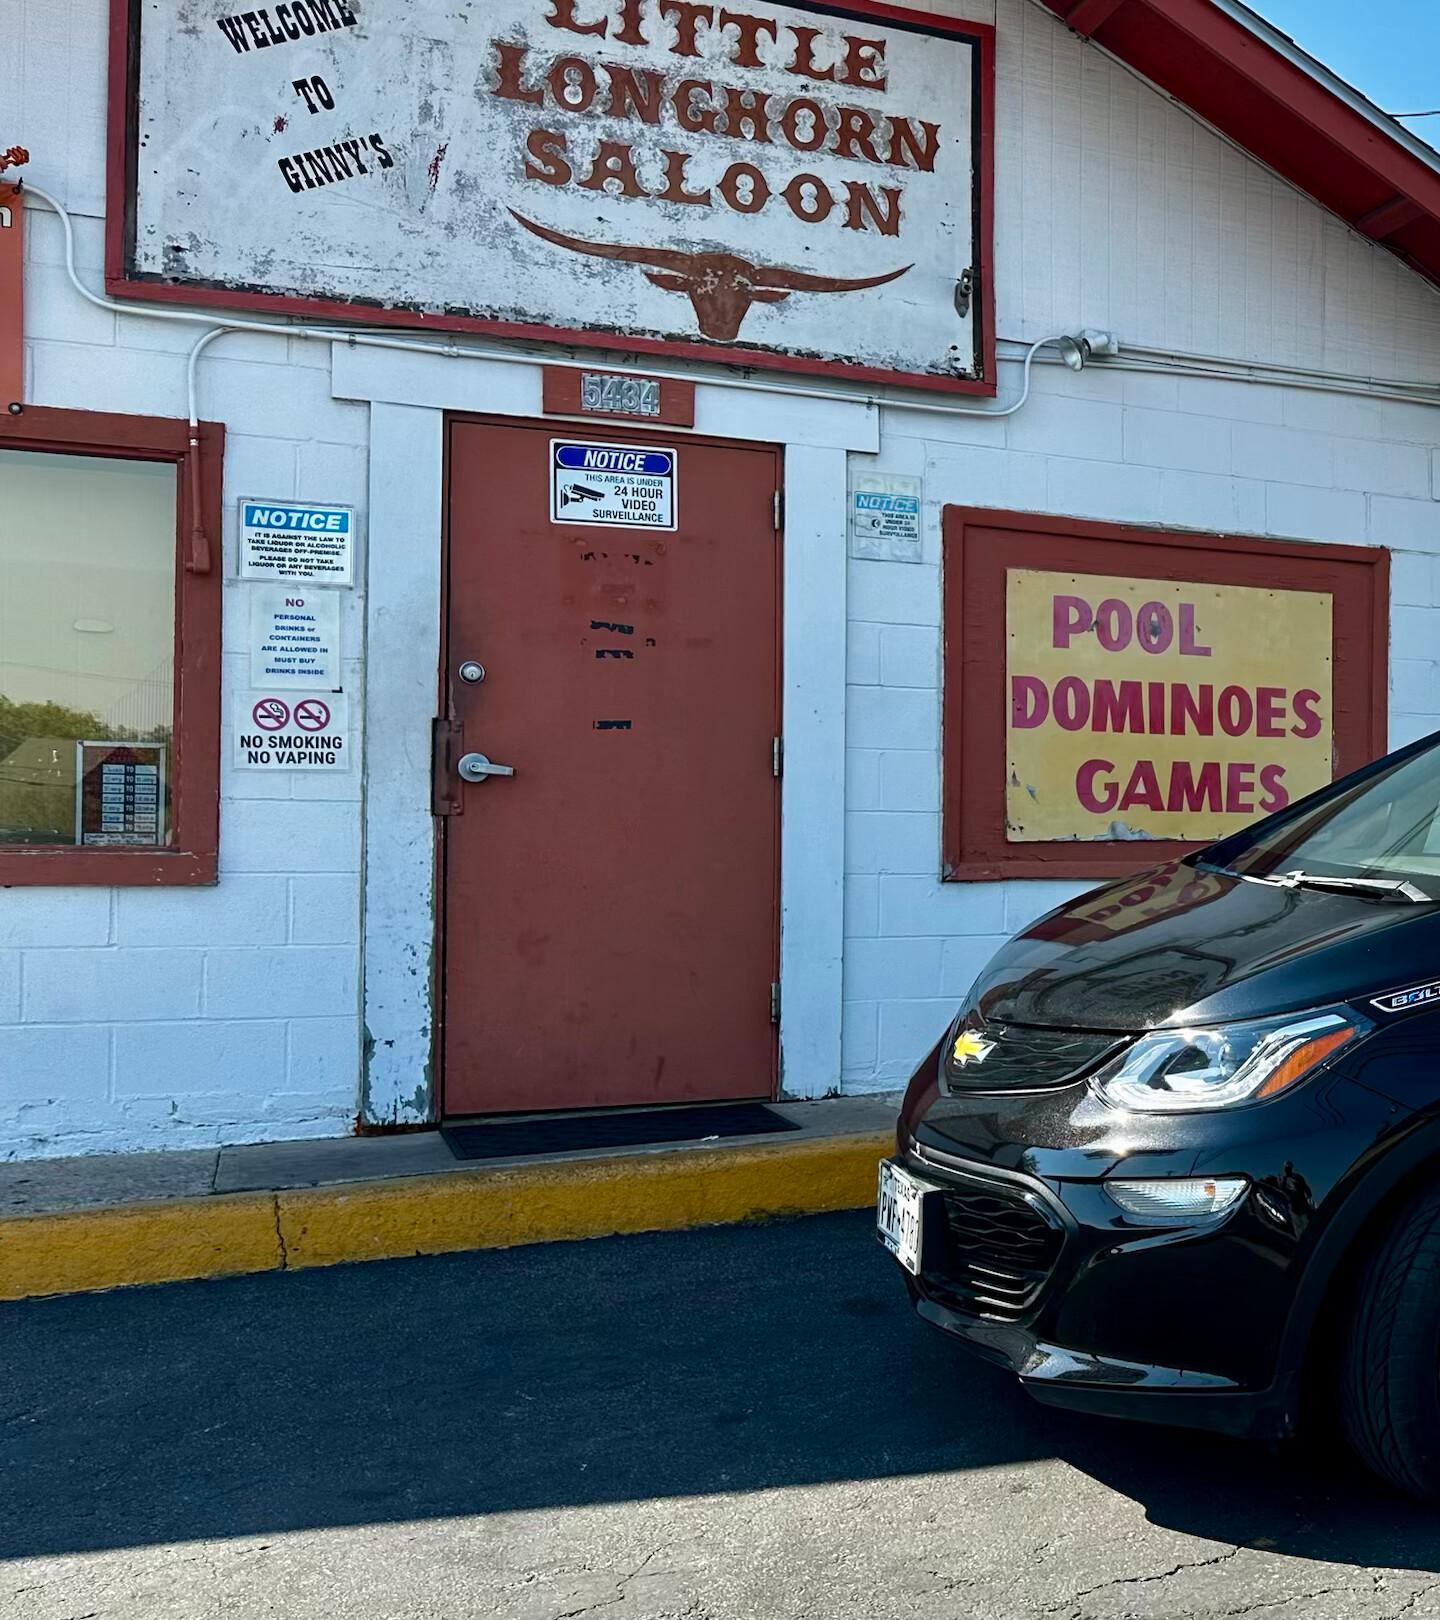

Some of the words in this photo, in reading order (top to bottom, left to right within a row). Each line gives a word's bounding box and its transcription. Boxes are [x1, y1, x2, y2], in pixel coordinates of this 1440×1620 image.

[217, 0, 358, 54] WELCOME
[545, 0, 887, 92] LITTLE
[292, 75, 336, 115] TO
[491, 44, 941, 173] LONGHORN
[278, 133, 394, 193] GINNY'S
[525, 129, 902, 238] SALOON
[582, 377, 659, 414] 5434
[583, 450, 647, 471] NOTICE
[585, 473, 603, 483] THIS
[605, 475, 625, 484] AREA
[627, 477, 635, 485] IS
[636, 478, 663, 487] UNDER
[614, 486, 628, 496] 24
[632, 487, 663, 499] HOUR
[593, 509, 663, 522] SURVEILLANCE
[621, 499, 656, 511] VIDEO
[857, 495, 917, 512] NOTICE
[251, 509, 342, 530] NOTICE
[285, 598, 305, 607] NO
[1052, 595, 1212, 657] POOL
[1011, 675, 1323, 739] DOMINOES
[240, 735, 263, 748] NO
[268, 735, 343, 749] SMOKING
[248, 751, 271, 764] NO
[276, 751, 336, 764] VAPING
[1076, 758, 1289, 814] GAMES
